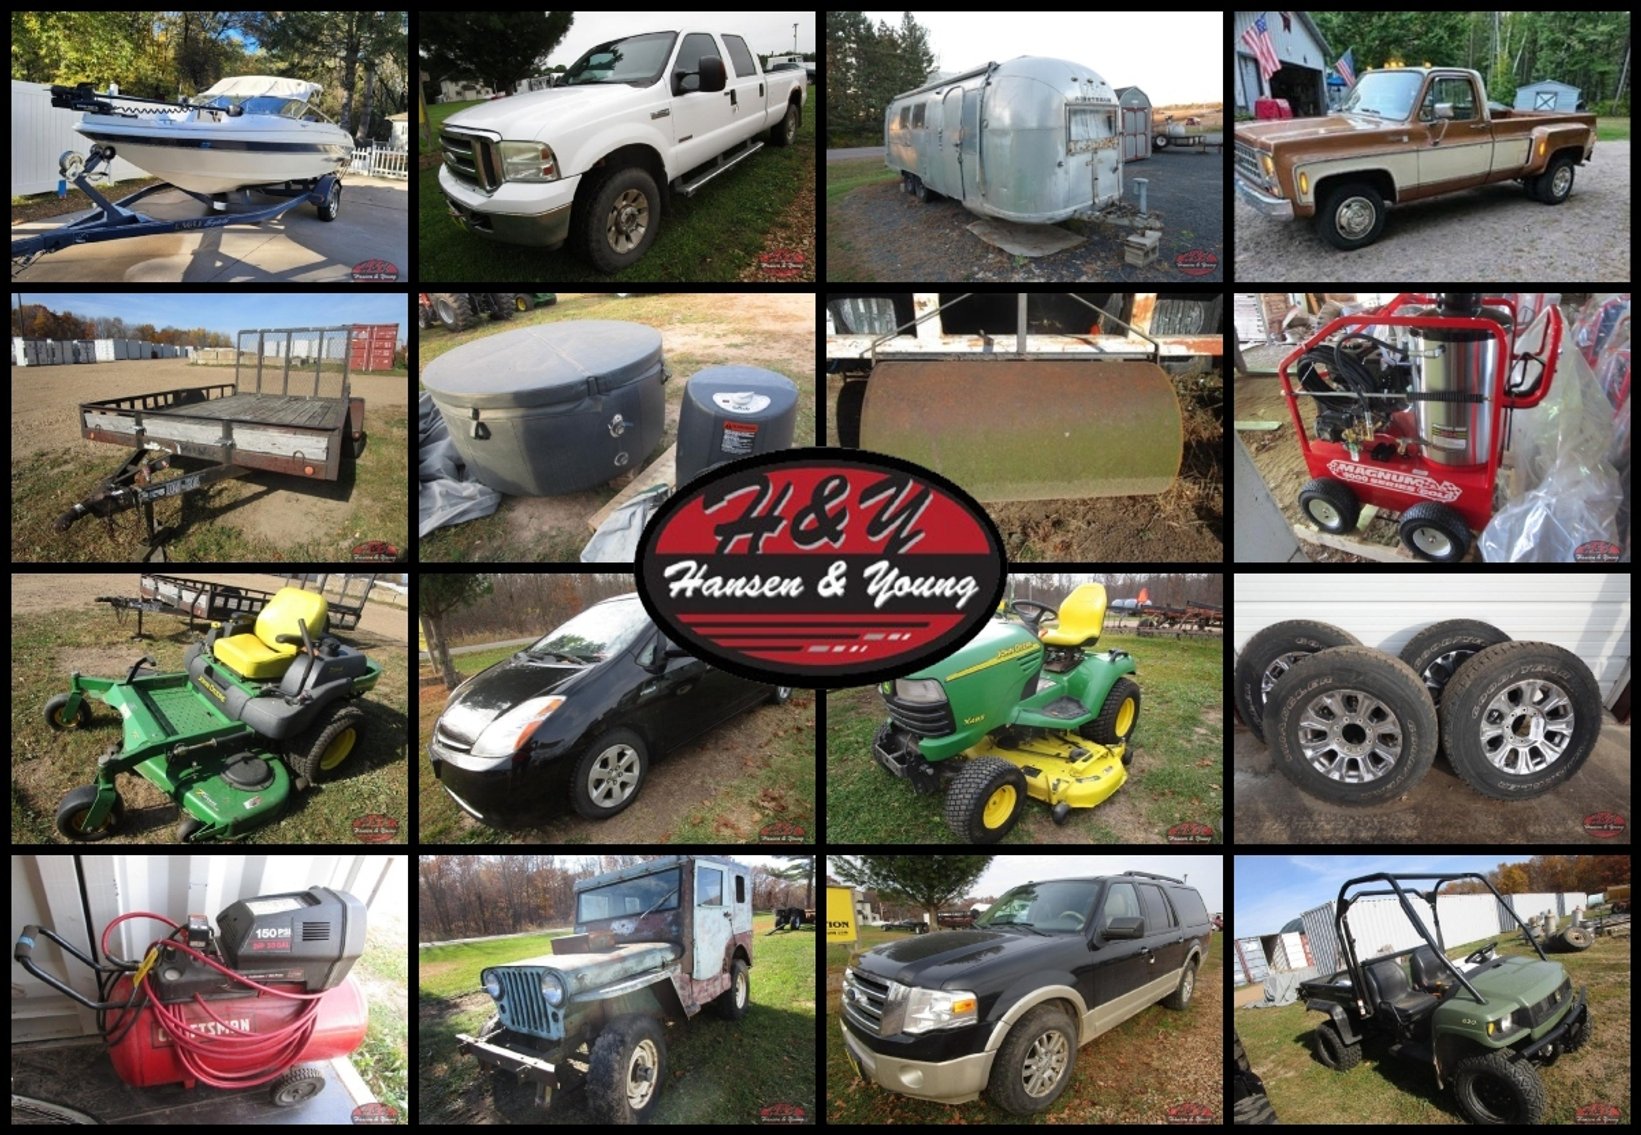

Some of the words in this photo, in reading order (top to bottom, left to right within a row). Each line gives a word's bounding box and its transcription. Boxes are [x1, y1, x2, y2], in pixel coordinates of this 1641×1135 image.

[1338, 463, 1425, 487] MAGNUM
[1370, 478, 1416, 492] SERIES
[255, 928, 277, 939] 150
[278, 928, 291, 938] PSI
[158, 1018, 250, 1042] CFTSMAN
